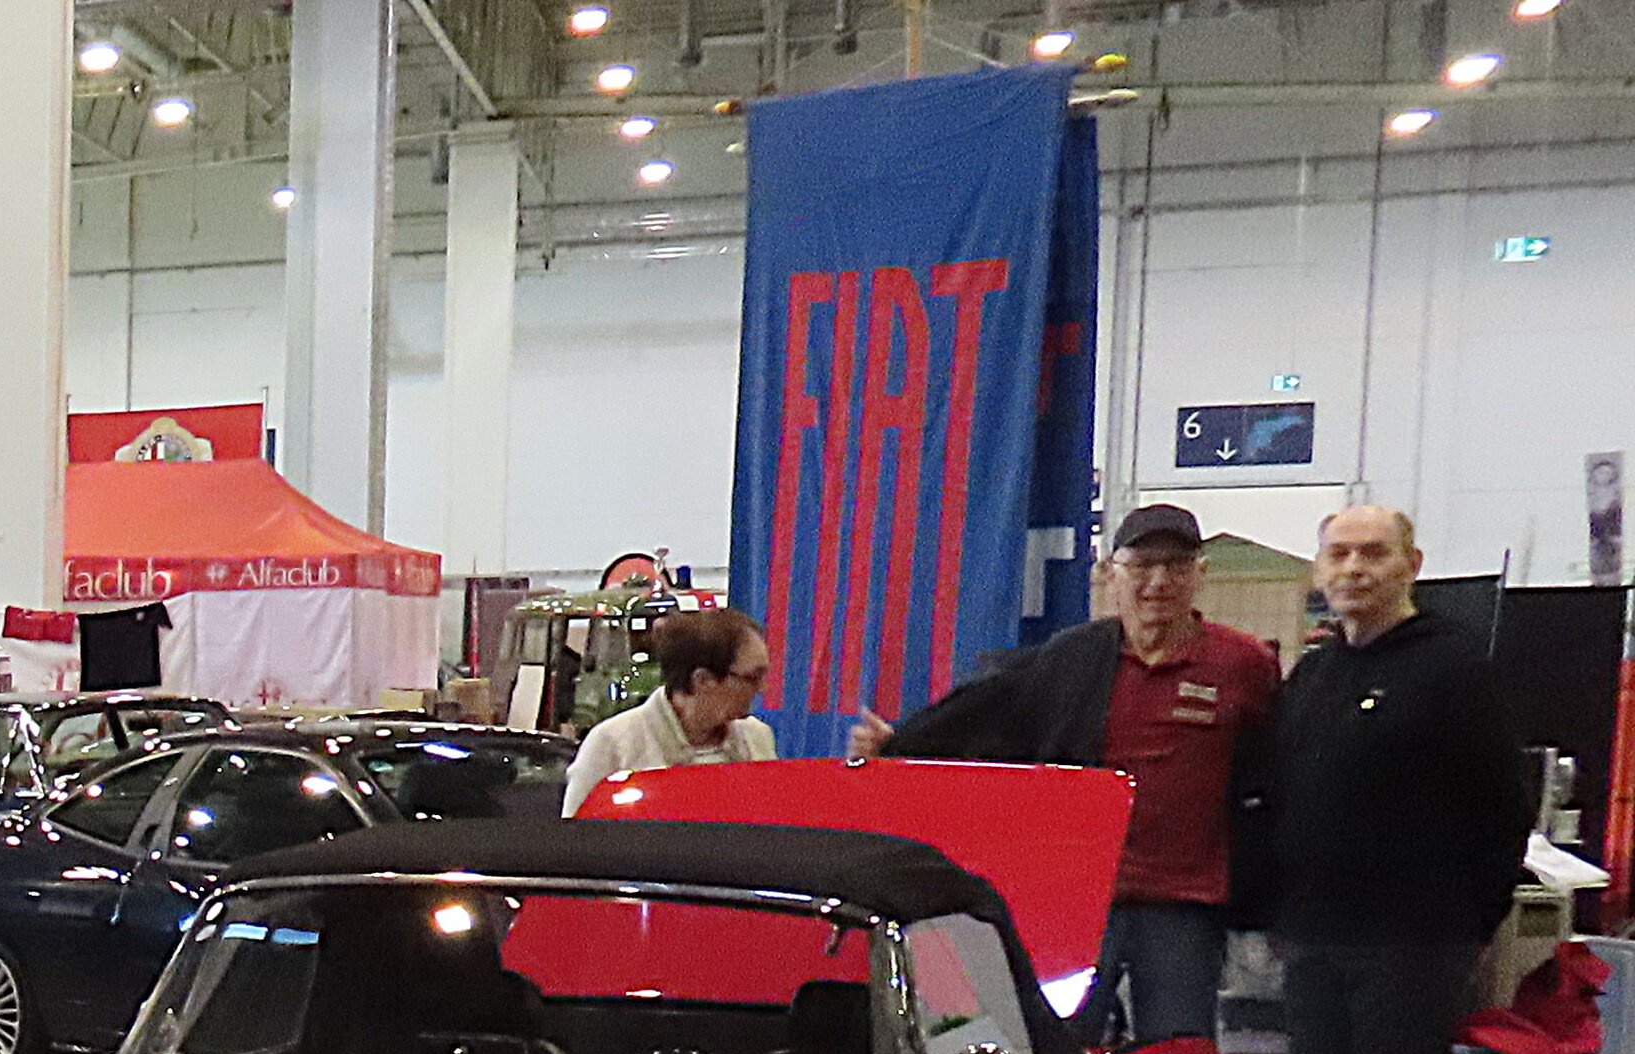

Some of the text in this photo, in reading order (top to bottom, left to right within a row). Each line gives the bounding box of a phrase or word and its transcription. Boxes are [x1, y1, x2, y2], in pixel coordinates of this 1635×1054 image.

[1183, 412, 1202, 439] 6
[762, 258, 1009, 720] FIAT
[238, 557, 340, 588] Alfaclub
